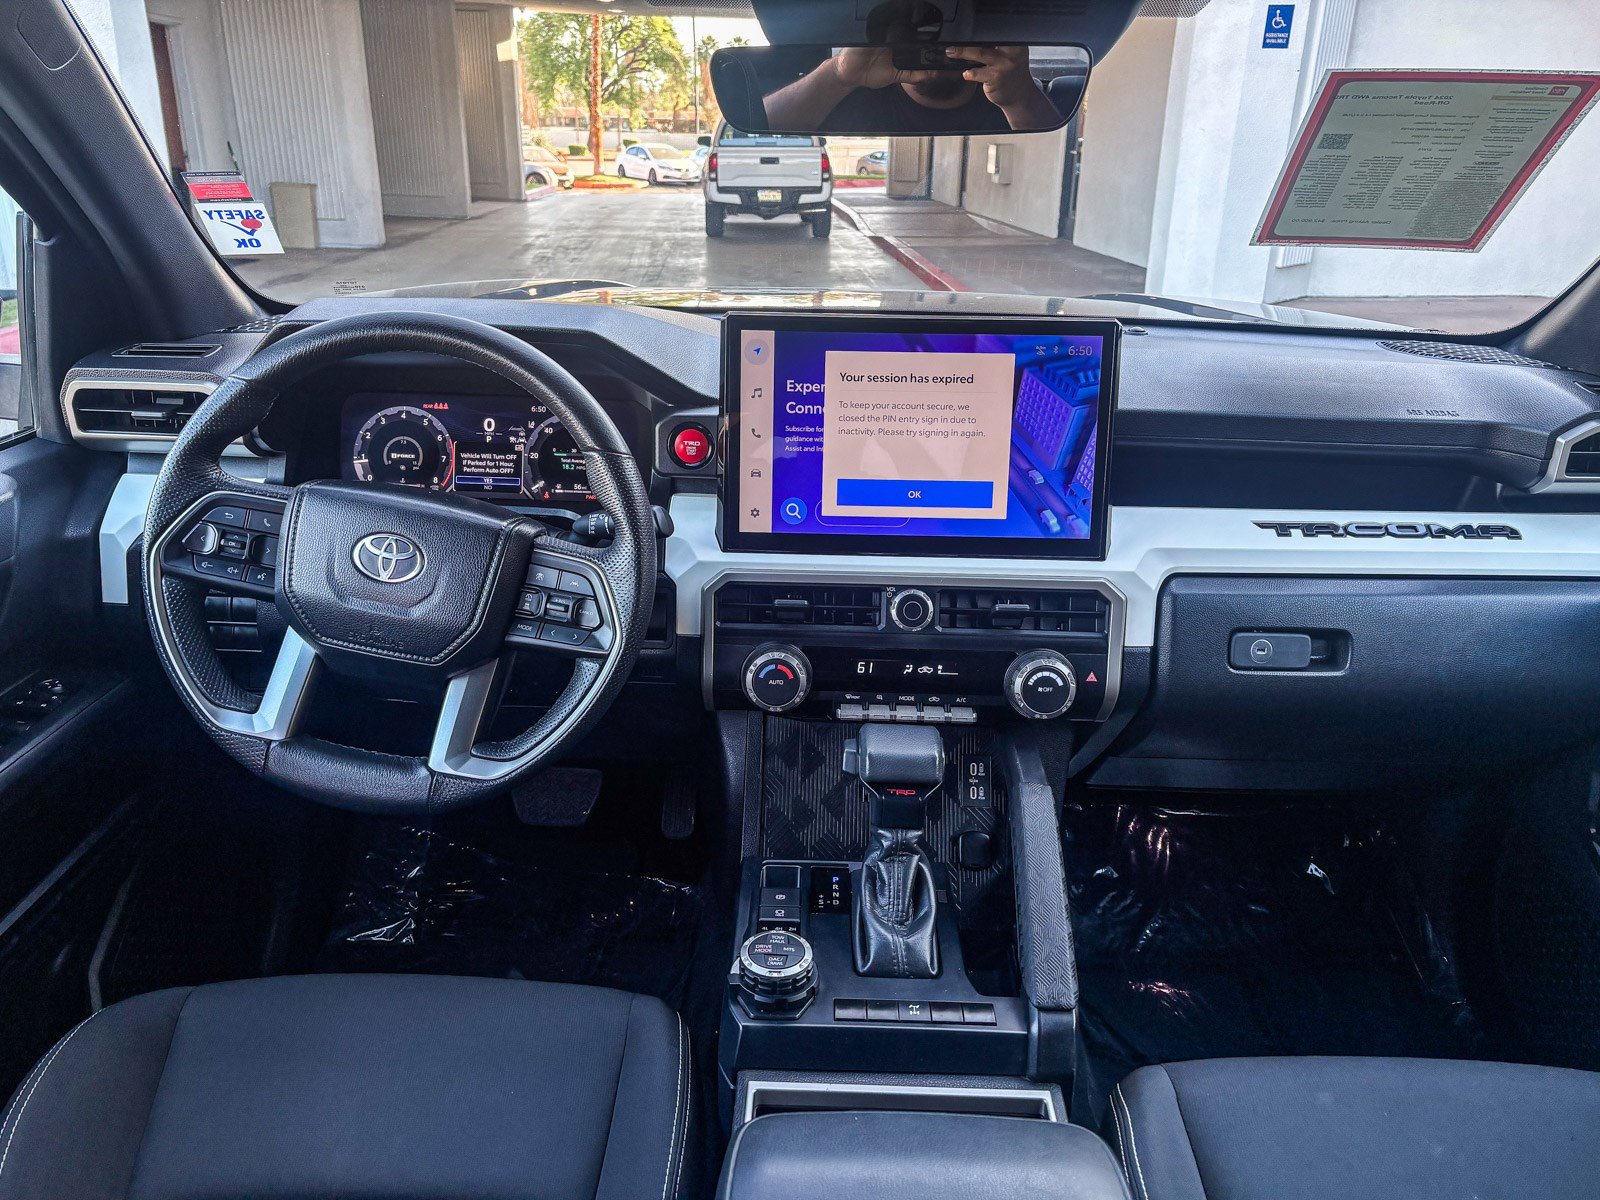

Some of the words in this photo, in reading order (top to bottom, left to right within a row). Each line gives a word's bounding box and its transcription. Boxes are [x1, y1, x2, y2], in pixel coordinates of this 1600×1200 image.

[1068, 344, 1092, 356] 6:50
[840, 372, 864, 383] Your
[867, 372, 908, 384] session
[910, 373, 930, 384] has
[932, 374, 974, 386] expired
[839, 401, 848, 409] To
[850, 401, 870, 412] keep
[872, 402, 890, 412] your
[892, 402, 924, 410] account
[926, 403, 956, 412] secure,
[484, 418, 496, 432] 0
[838, 414, 866, 423] closed
[867, 414, 881, 423] the
[882, 415, 897, 423] PIN
[898, 416, 920, 424] entry
[921, 416, 939, 426] sign
[940, 416, 948, 424] in
[949, 416, 967, 424] due
[838, 428, 876, 437] inactivity.
[878, 428, 904, 437] Please
[906, 430, 917, 438] try
[918, 430, 949, 439] signing
[960, 430, 986, 440] again.
[908, 490, 922, 498] OK
[1250, 520, 1523, 540] TACOMA
[516, 623, 533, 632] MODE
[857, 662, 874, 674] 61
